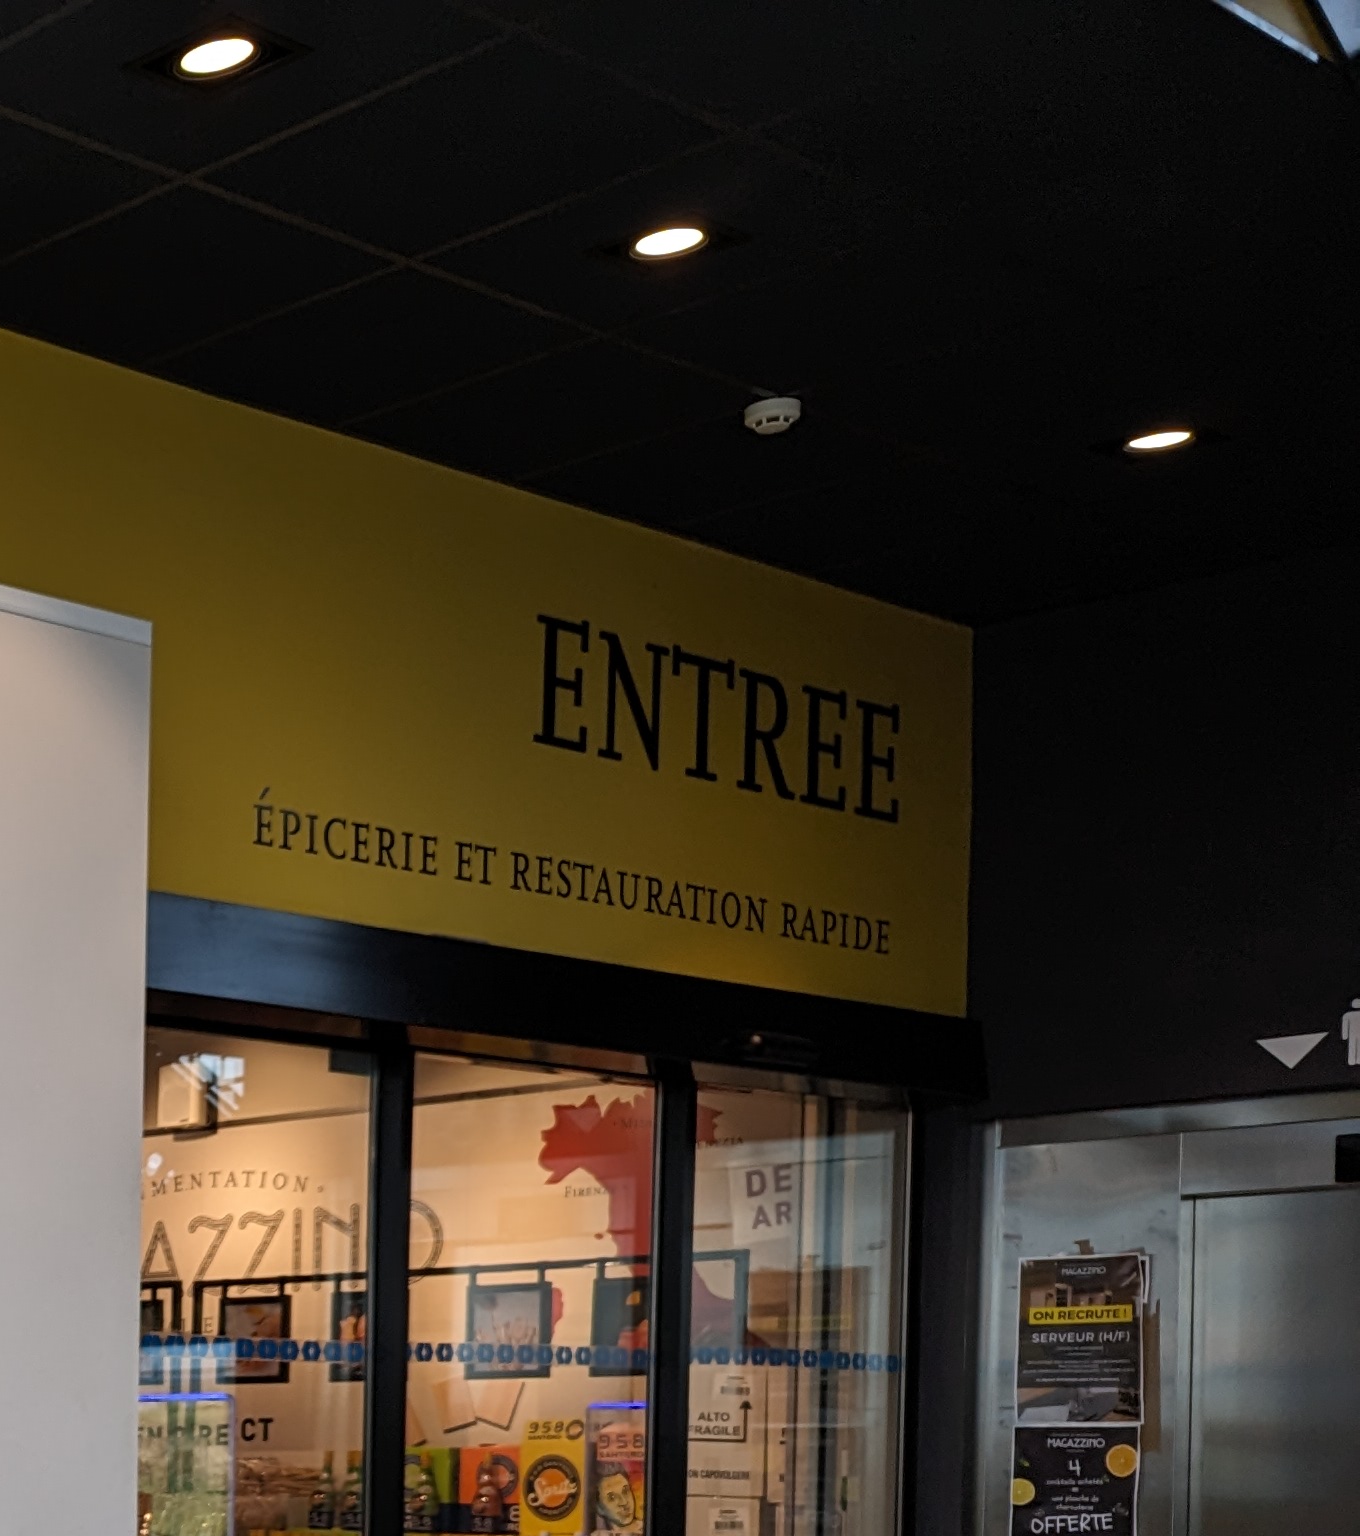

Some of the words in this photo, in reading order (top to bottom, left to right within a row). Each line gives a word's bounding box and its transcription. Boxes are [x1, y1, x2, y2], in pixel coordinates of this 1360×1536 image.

[533, 614, 901, 823] ENTREE
[252, 787, 438, 876] ÉPICERIE
[454, 841, 496, 885] ET
[510, 851, 769, 933] RESTAURATION
[780, 901, 892, 955] RAPIDE
[142, 1170, 309, 1198] MENTATION
[1033, 1310, 1054, 1321] ON
[1058, 1308, 1120, 1321] RECRUTE
[1032, 1331, 1094, 1343] SERVEUR
[1099, 1330, 1130, 1342] (H/F)
[697, 1411, 730, 1422] ALTO
[528, 1421, 565, 1434] 958
[1047, 1437, 1105, 1449] MAGAZZINO
[1068, 1458, 1081, 1477] 4
[1031, 1512, 1113, 1534] OFFERTE
